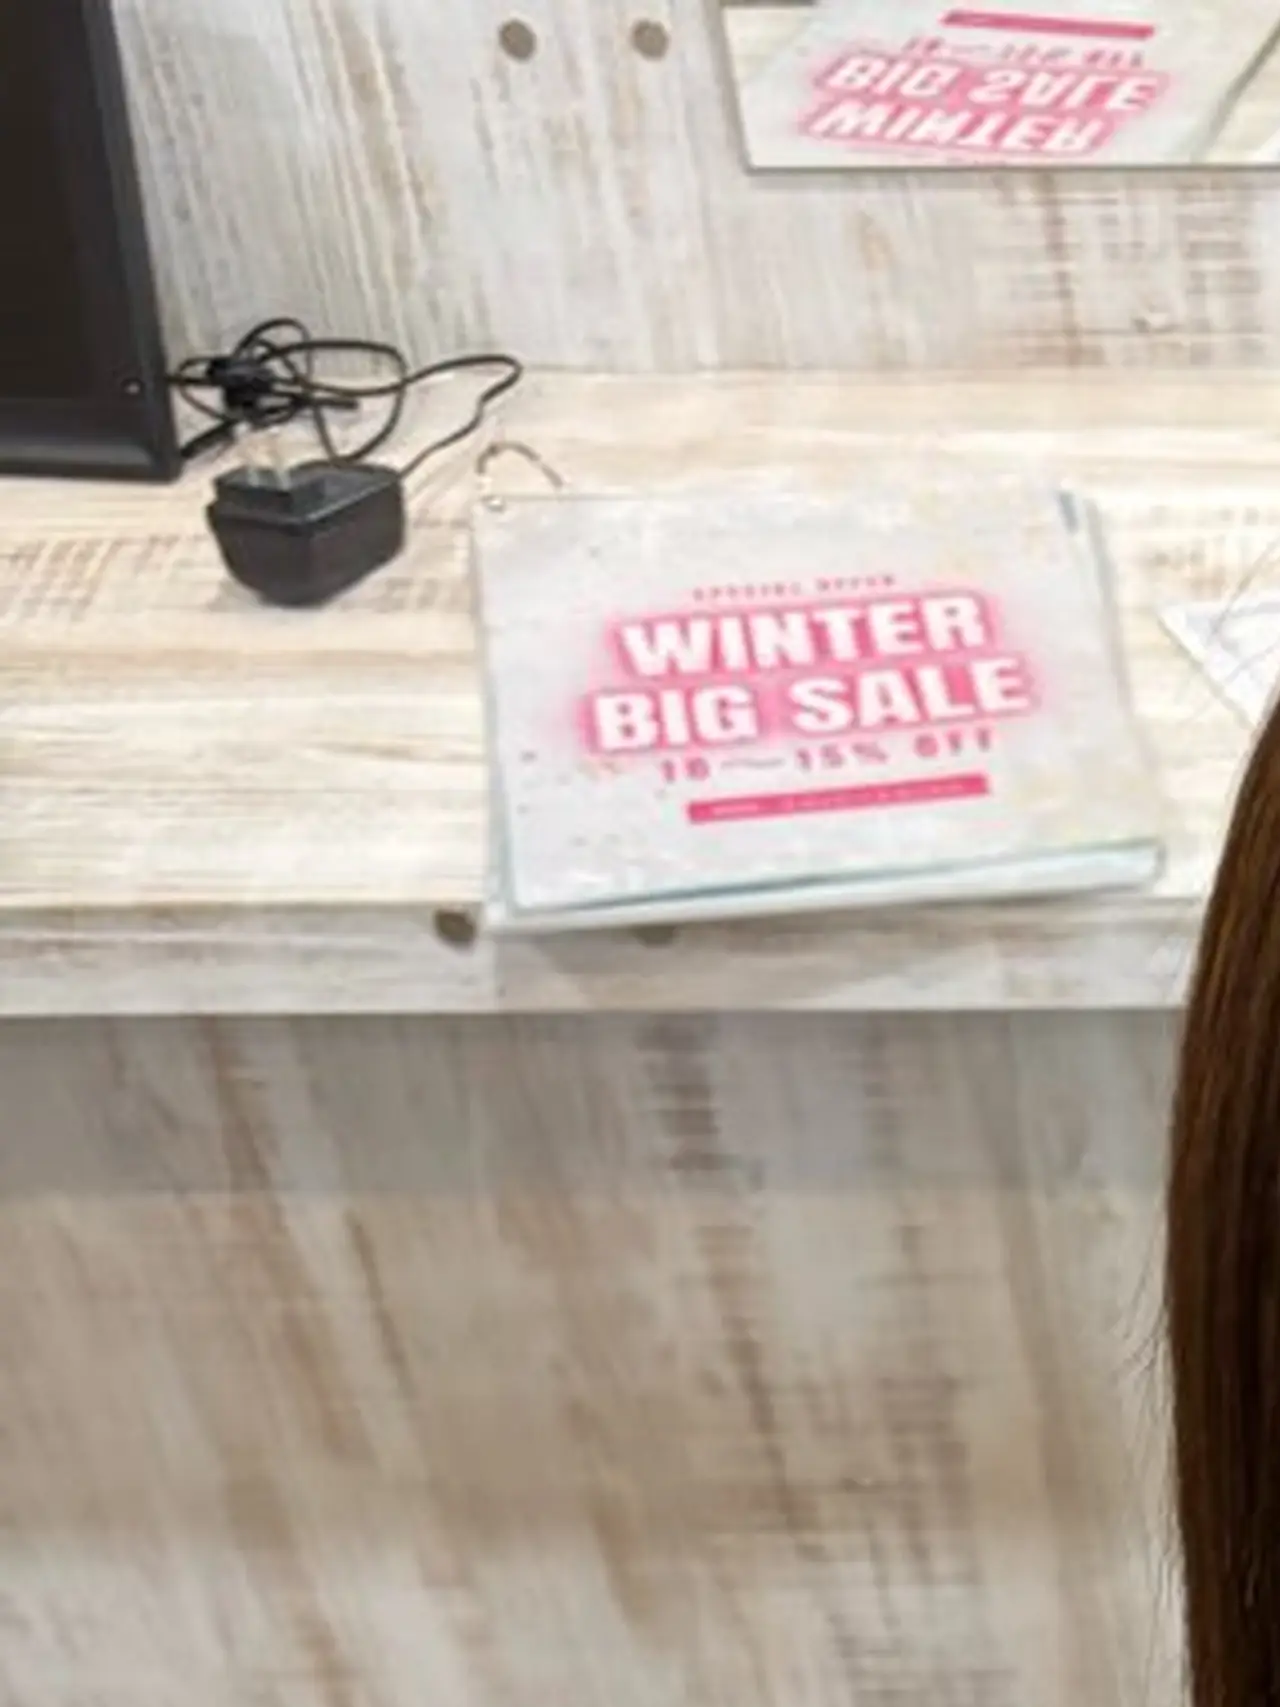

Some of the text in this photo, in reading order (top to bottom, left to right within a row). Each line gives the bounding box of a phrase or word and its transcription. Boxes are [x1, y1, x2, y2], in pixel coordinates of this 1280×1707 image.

[619, 596, 987, 677] WINTER
[595, 656, 1030, 750] BIG SALE
